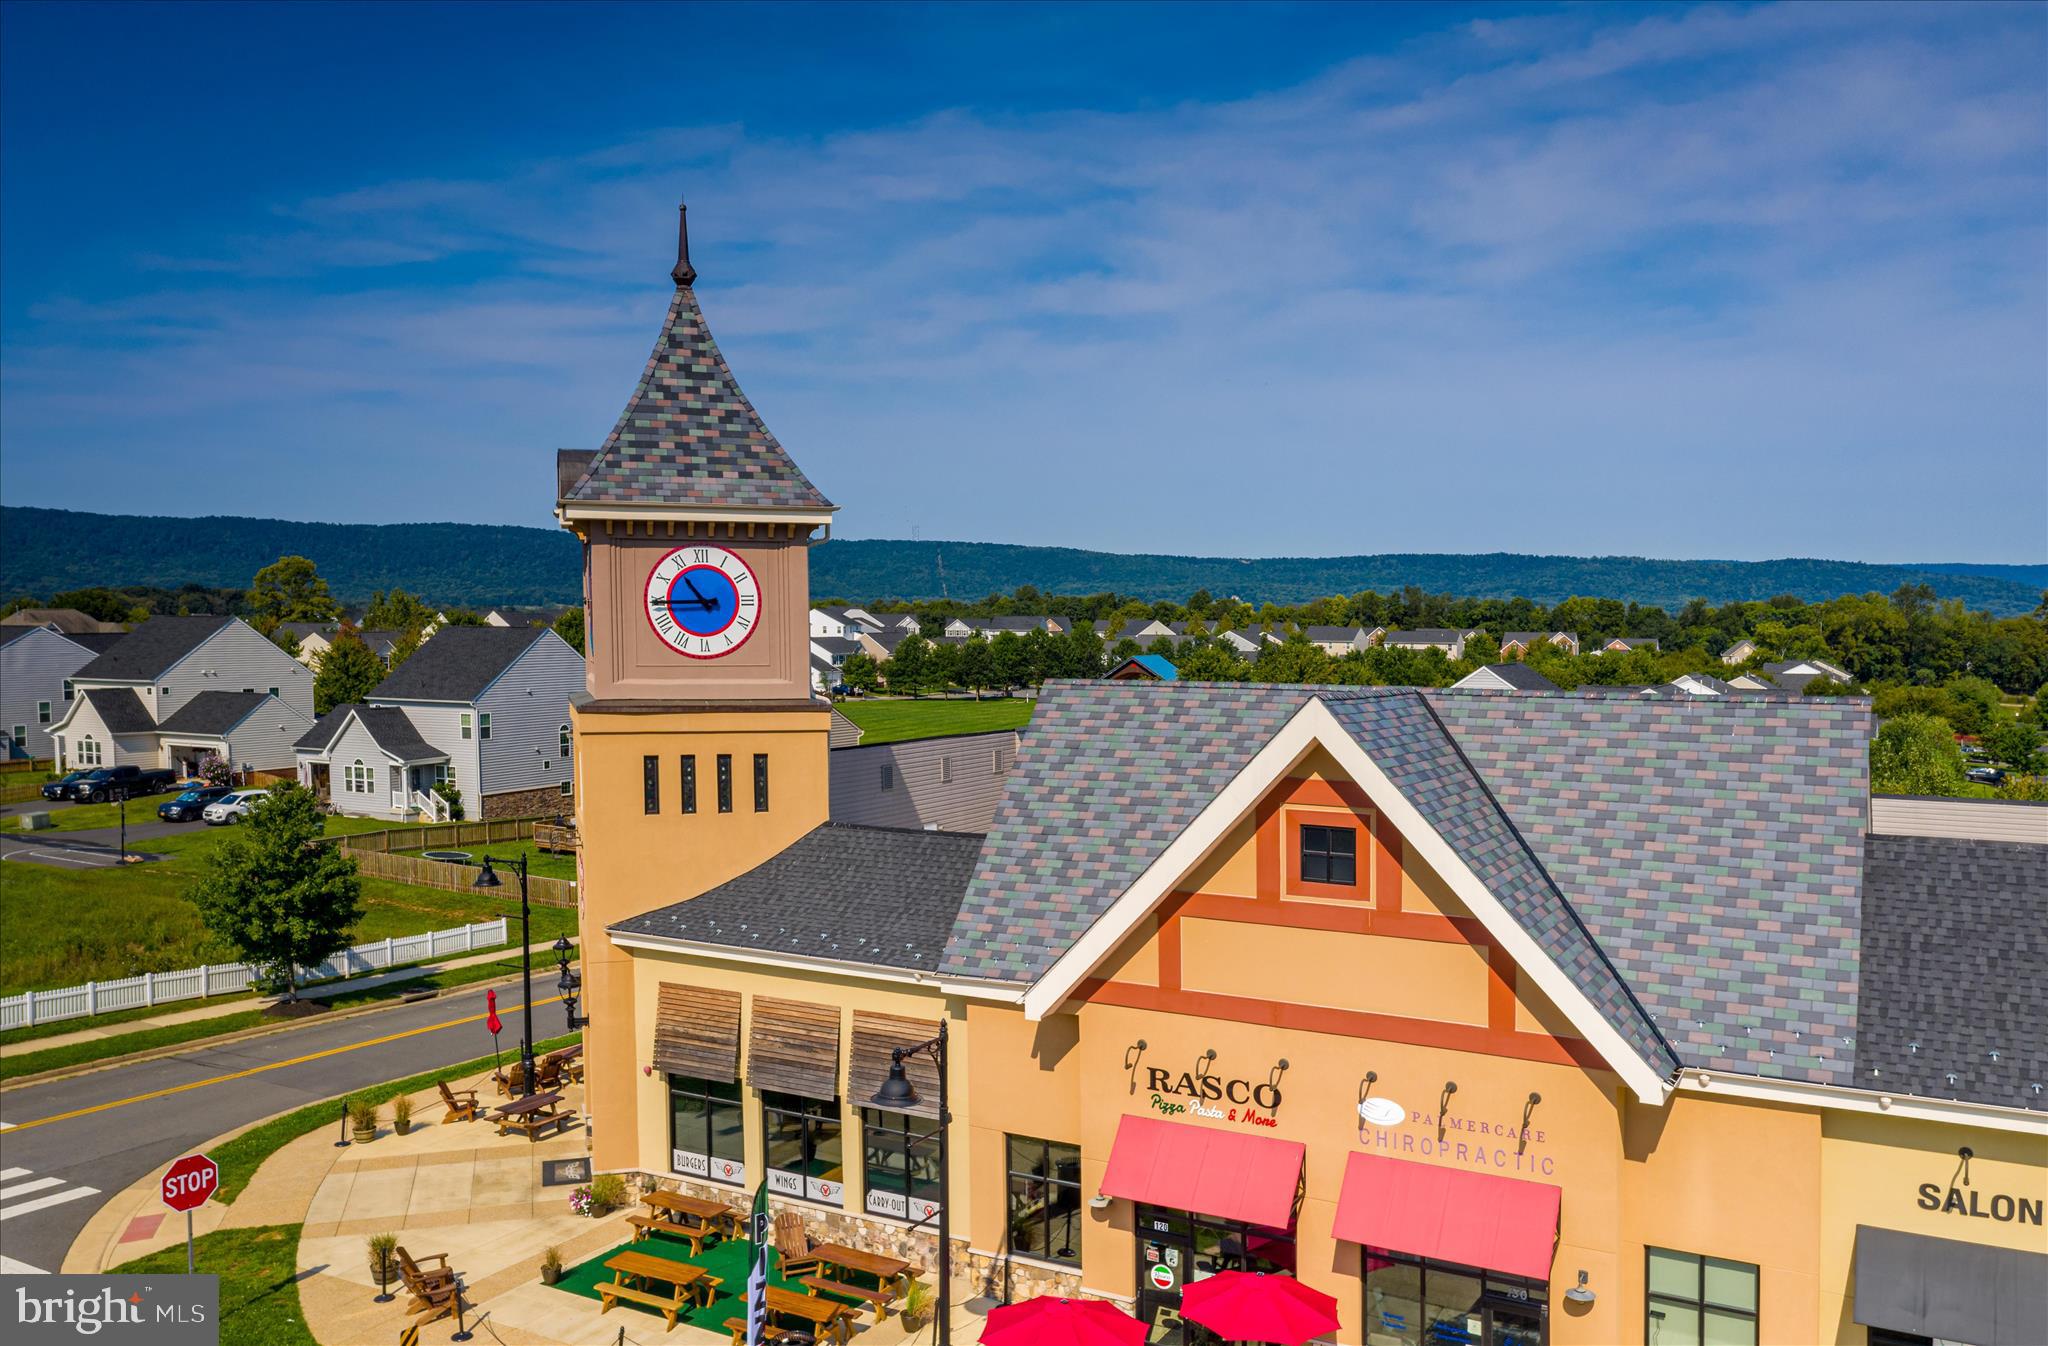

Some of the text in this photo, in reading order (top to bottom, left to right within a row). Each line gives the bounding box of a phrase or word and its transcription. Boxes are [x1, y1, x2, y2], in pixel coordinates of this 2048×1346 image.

[671, 554, 687, 570] XI
[693, 549, 708, 563] XII
[719, 556, 728, 568] I
[656, 573, 670, 584] X
[733, 572, 748, 584] II
[741, 594, 754, 606] III
[655, 613, 672, 635] VIII
[737, 615, 750, 630] IV
[673, 631, 689, 649] VII
[700, 638, 711, 652] VI
[723, 634, 733, 646] V
[1146, 1067, 1282, 1109] RASCO
[1151, 1093, 1278, 1128] Pizza Pasta & More
[1411, 1111, 1546, 1143] PALMERCARE
[1359, 1128, 1554, 1176] CHIROPRACTIC
[676, 1154, 706, 1171] BURGERS
[165, 1168, 214, 1198] STOP
[774, 1174, 797, 1190] WINGS
[868, 1194, 905, 1212] CARRY-OUT
[1917, 1183, 2043, 1226] SALON
[1155, 1221, 1168, 1232] 120
